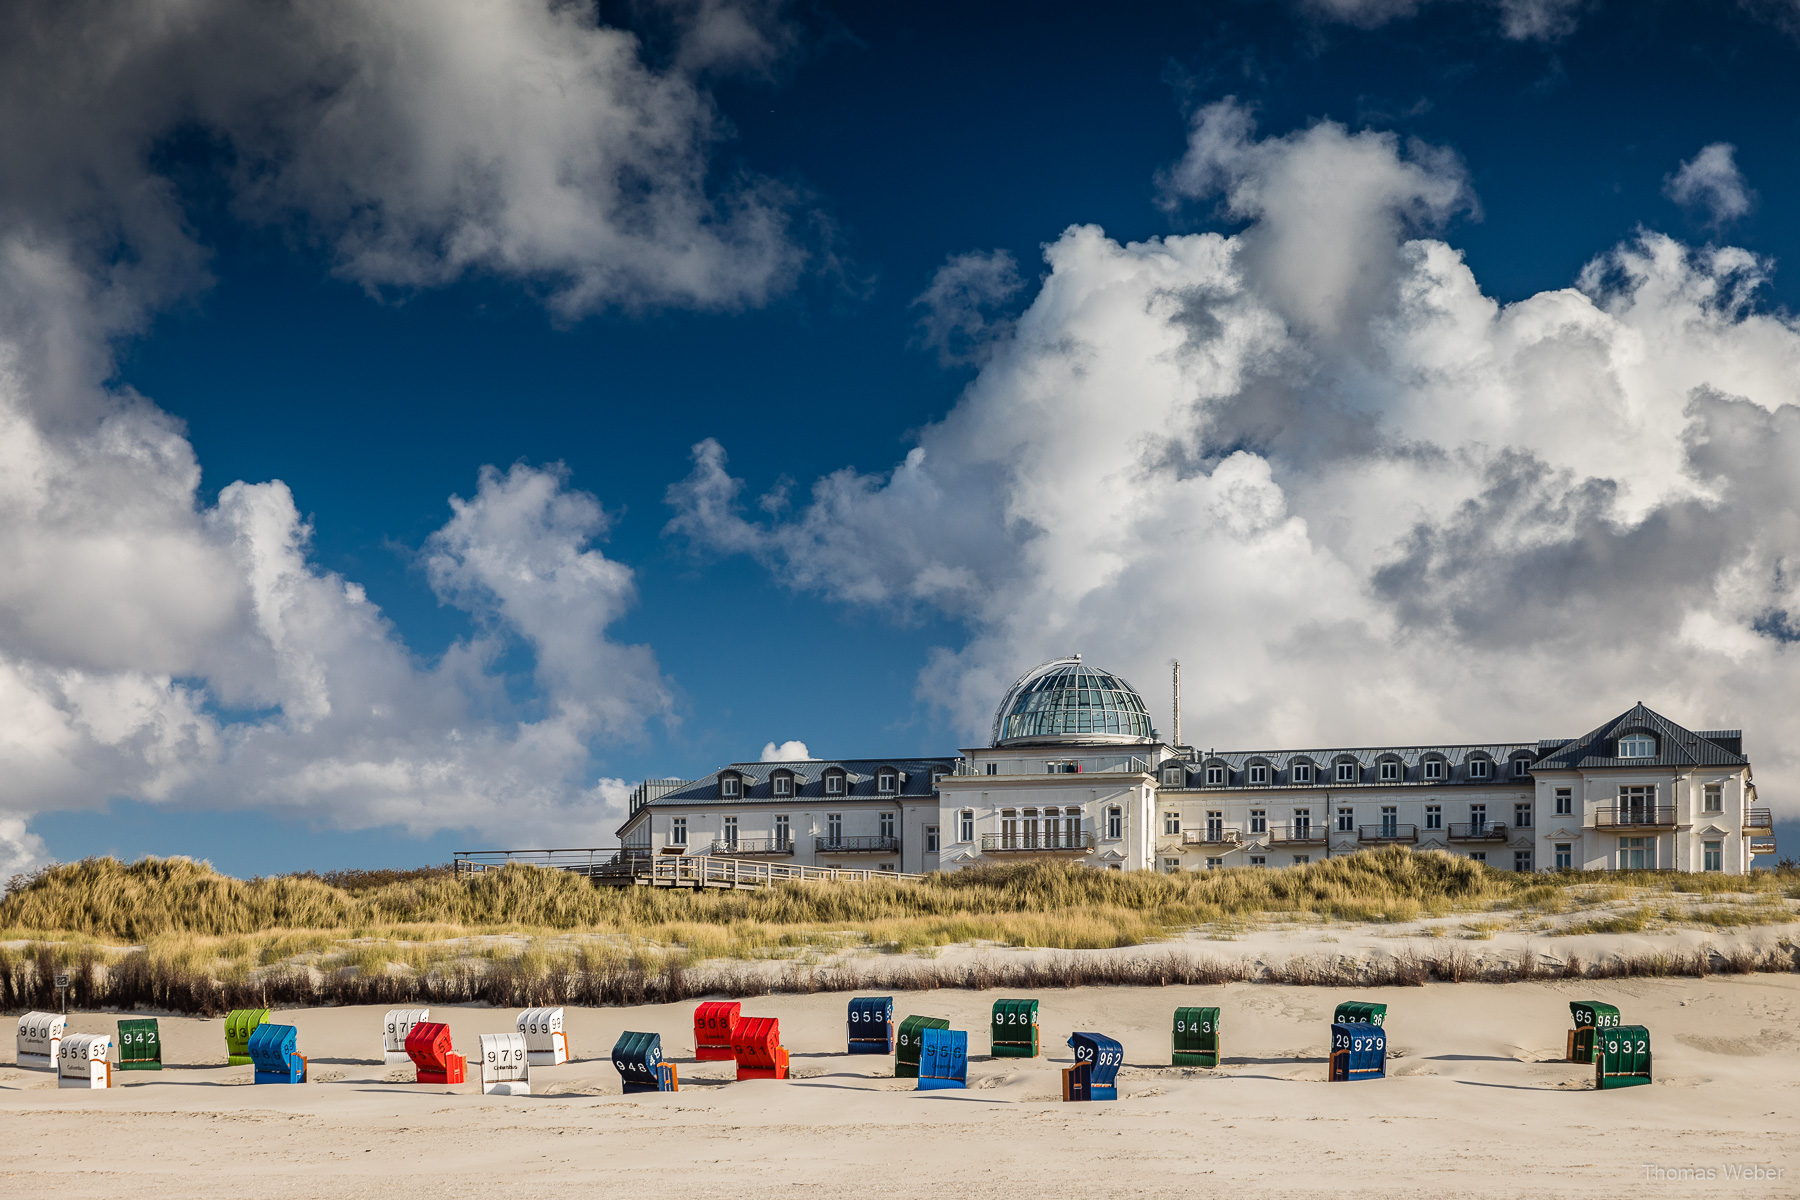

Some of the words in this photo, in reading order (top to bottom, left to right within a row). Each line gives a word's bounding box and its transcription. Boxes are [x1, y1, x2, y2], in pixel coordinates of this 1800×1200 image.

[552, 1017, 561, 1029] 99
[698, 1018, 728, 1029] 908
[851, 1011, 883, 1023] 955
[996, 1013, 1028, 1025] 926
[1373, 1014, 1383, 1026] 36
[1576, 1010, 1592, 1024] 65
[1597, 1015, 1618, 1027] 965
[20, 1026, 47, 1039] 980
[52, 1024, 62, 1036] 80
[519, 1023, 548, 1034] 999
[1177, 1020, 1211, 1033] 943
[123, 1032, 156, 1044] 942
[438, 1036, 450, 1053] 51
[1336, 1034, 1350, 1048] 29
[93, 1043, 106, 1057] 53
[283, 1039, 294, 1055] 89
[734, 1045, 767, 1056] 931
[1354, 1038, 1384, 1052] 929
[1608, 1040, 1646, 1054] 932
[60, 1047, 88, 1060] 953
[251, 1048, 281, 1060] 989
[408, 1049, 436, 1061] 951
[488, 1049, 523, 1063] 979
[649, 1047, 661, 1066] 48
[926, 1045, 962, 1059] 956
[1077, 1045, 1094, 1062] 62
[616, 1060, 647, 1072] 948
[1099, 1052, 1121, 1067] 962
